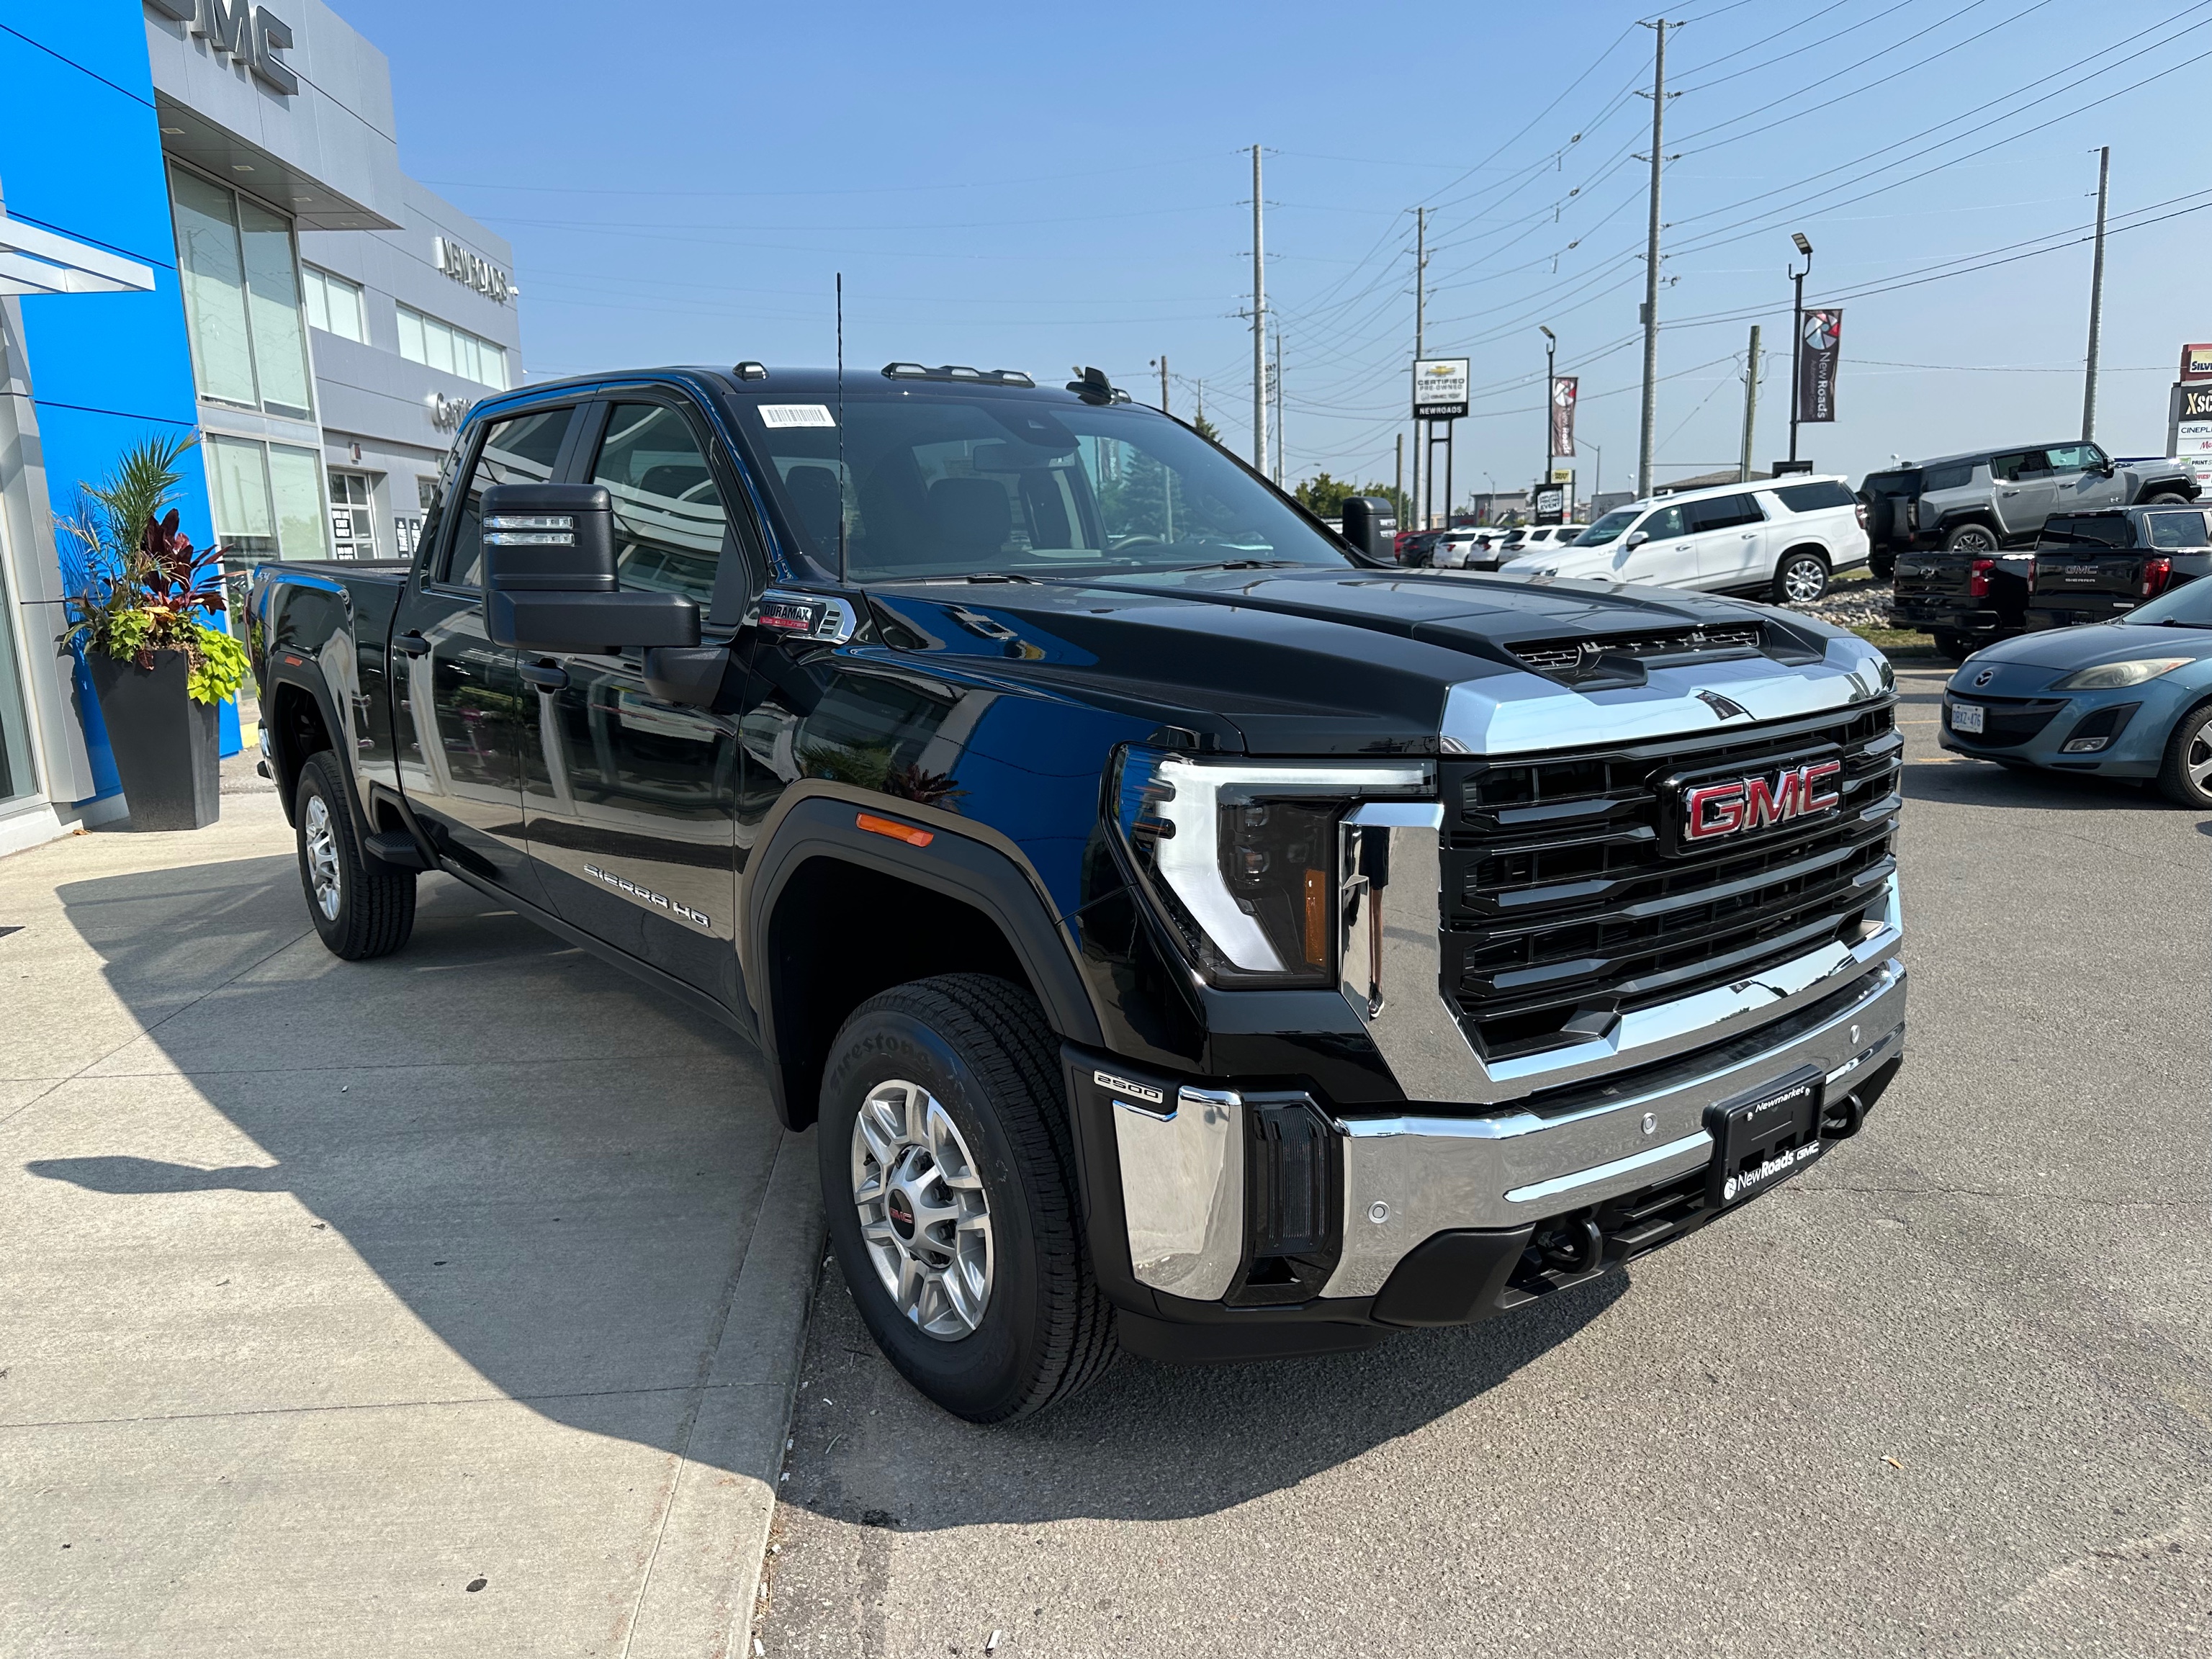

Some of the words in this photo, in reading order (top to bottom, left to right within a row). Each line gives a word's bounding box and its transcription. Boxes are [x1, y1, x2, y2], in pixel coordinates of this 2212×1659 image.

[433, 236, 508, 302] NEWROADS
[2191, 361, 2212, 371] SILV
[1817, 351, 1831, 419] NewRoads
[1419, 405, 1462, 415] NEWROADS
[2064, 565, 2098, 574] GMC
[764, 605, 810, 621] DURAMAX
[1686, 760, 1840, 841] GMC
[583, 863, 670, 909] SIERRA
[673, 901, 711, 929] HD
[829, 1030, 932, 1097] Firestone
[1097, 1075, 1159, 1099] 2500
[1755, 1085, 1805, 1113] Newmarket
[1737, 1150, 1794, 1192] NewRoads
[1796, 1141, 1820, 1161] GMC
[889, 1207, 912, 1224] GMC
